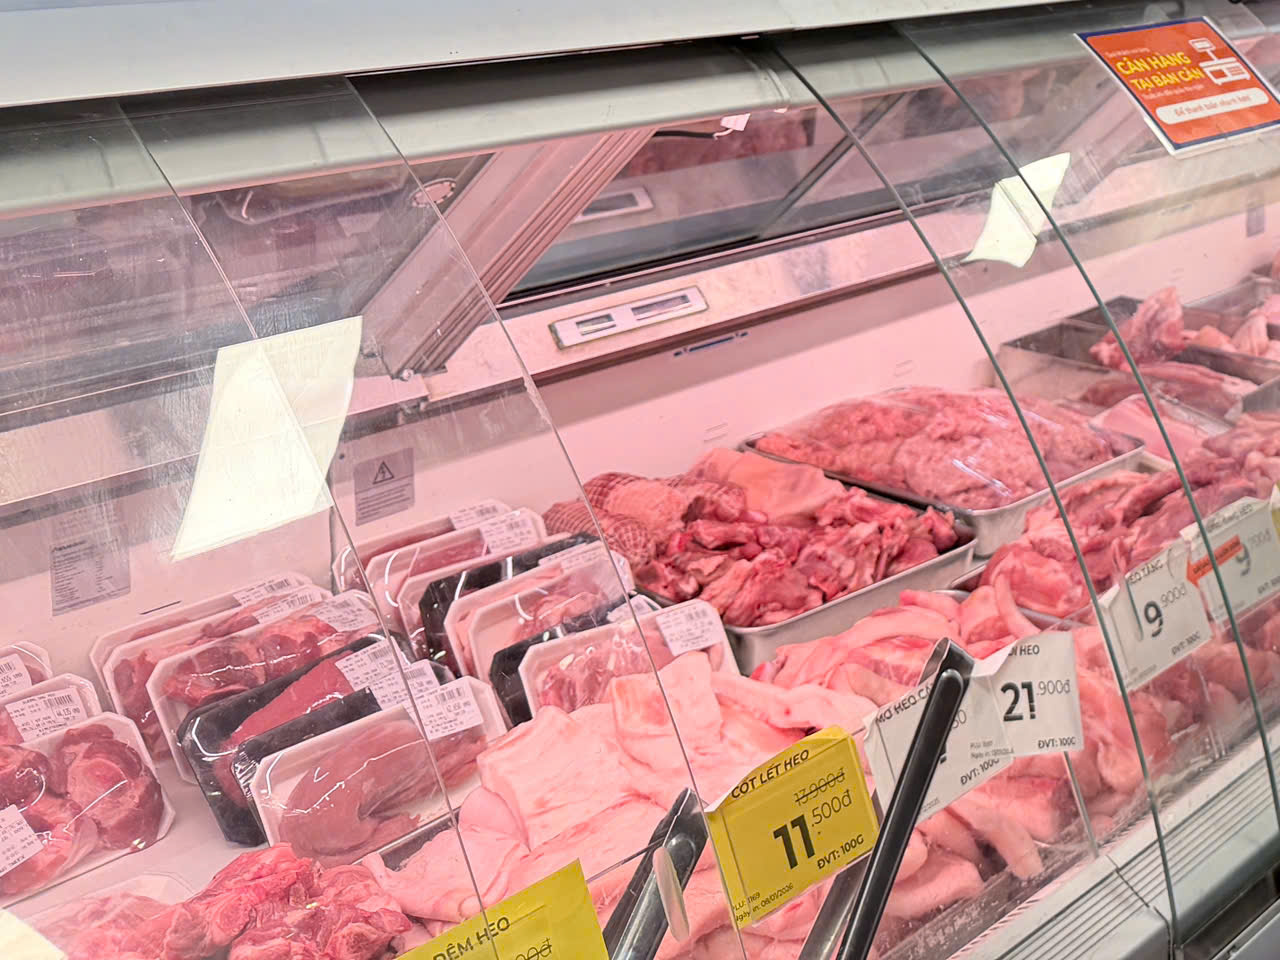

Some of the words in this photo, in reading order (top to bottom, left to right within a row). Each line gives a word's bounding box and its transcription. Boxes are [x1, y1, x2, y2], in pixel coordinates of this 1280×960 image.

[1146, 52, 1191, 69] HÀNG
[1151, 72, 1180, 87] BÀN
[1019, 644, 1040, 656] HEO
[894, 695, 918, 715] HEO
[1038, 738, 1058, 749] ĐVT:
[784, 749, 809, 771] HEO
[960, 767, 980, 785] ĐVT:
[817, 849, 840, 869] ĐVT:
[840, 834, 865, 854] 100G
[732, 900, 747, 911] LU:
[476, 916, 511, 945] HEO
